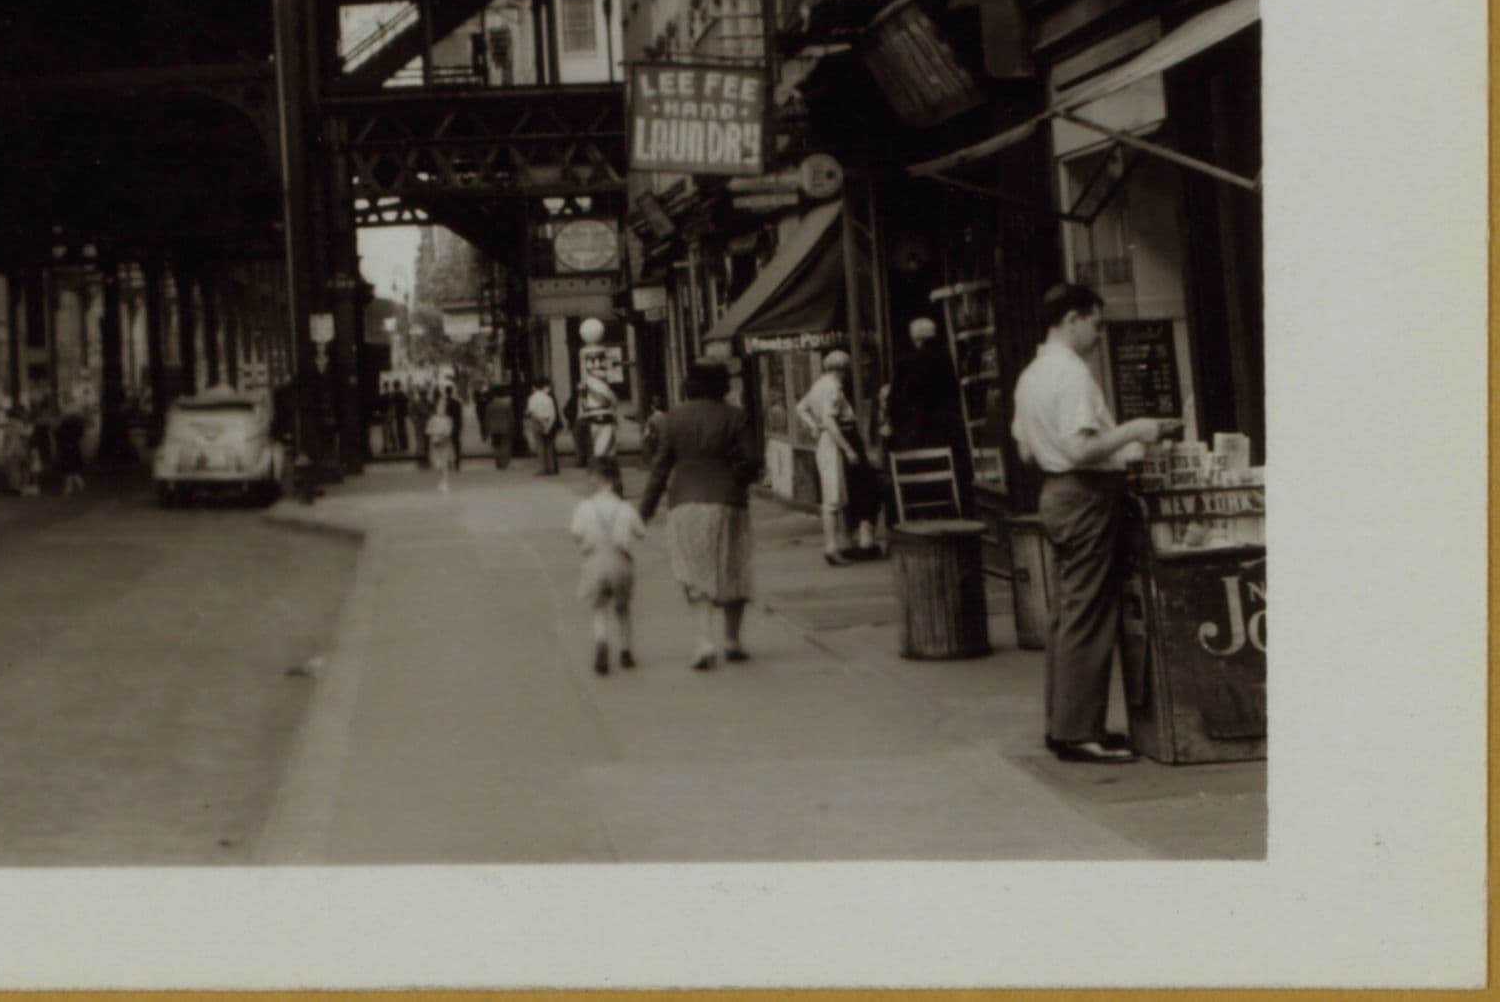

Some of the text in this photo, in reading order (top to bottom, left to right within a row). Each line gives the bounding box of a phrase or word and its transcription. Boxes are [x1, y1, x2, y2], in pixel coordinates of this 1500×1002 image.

[640, 71, 760, 102] LEE FEE
[634, 117, 762, 166] LAUNDRY
